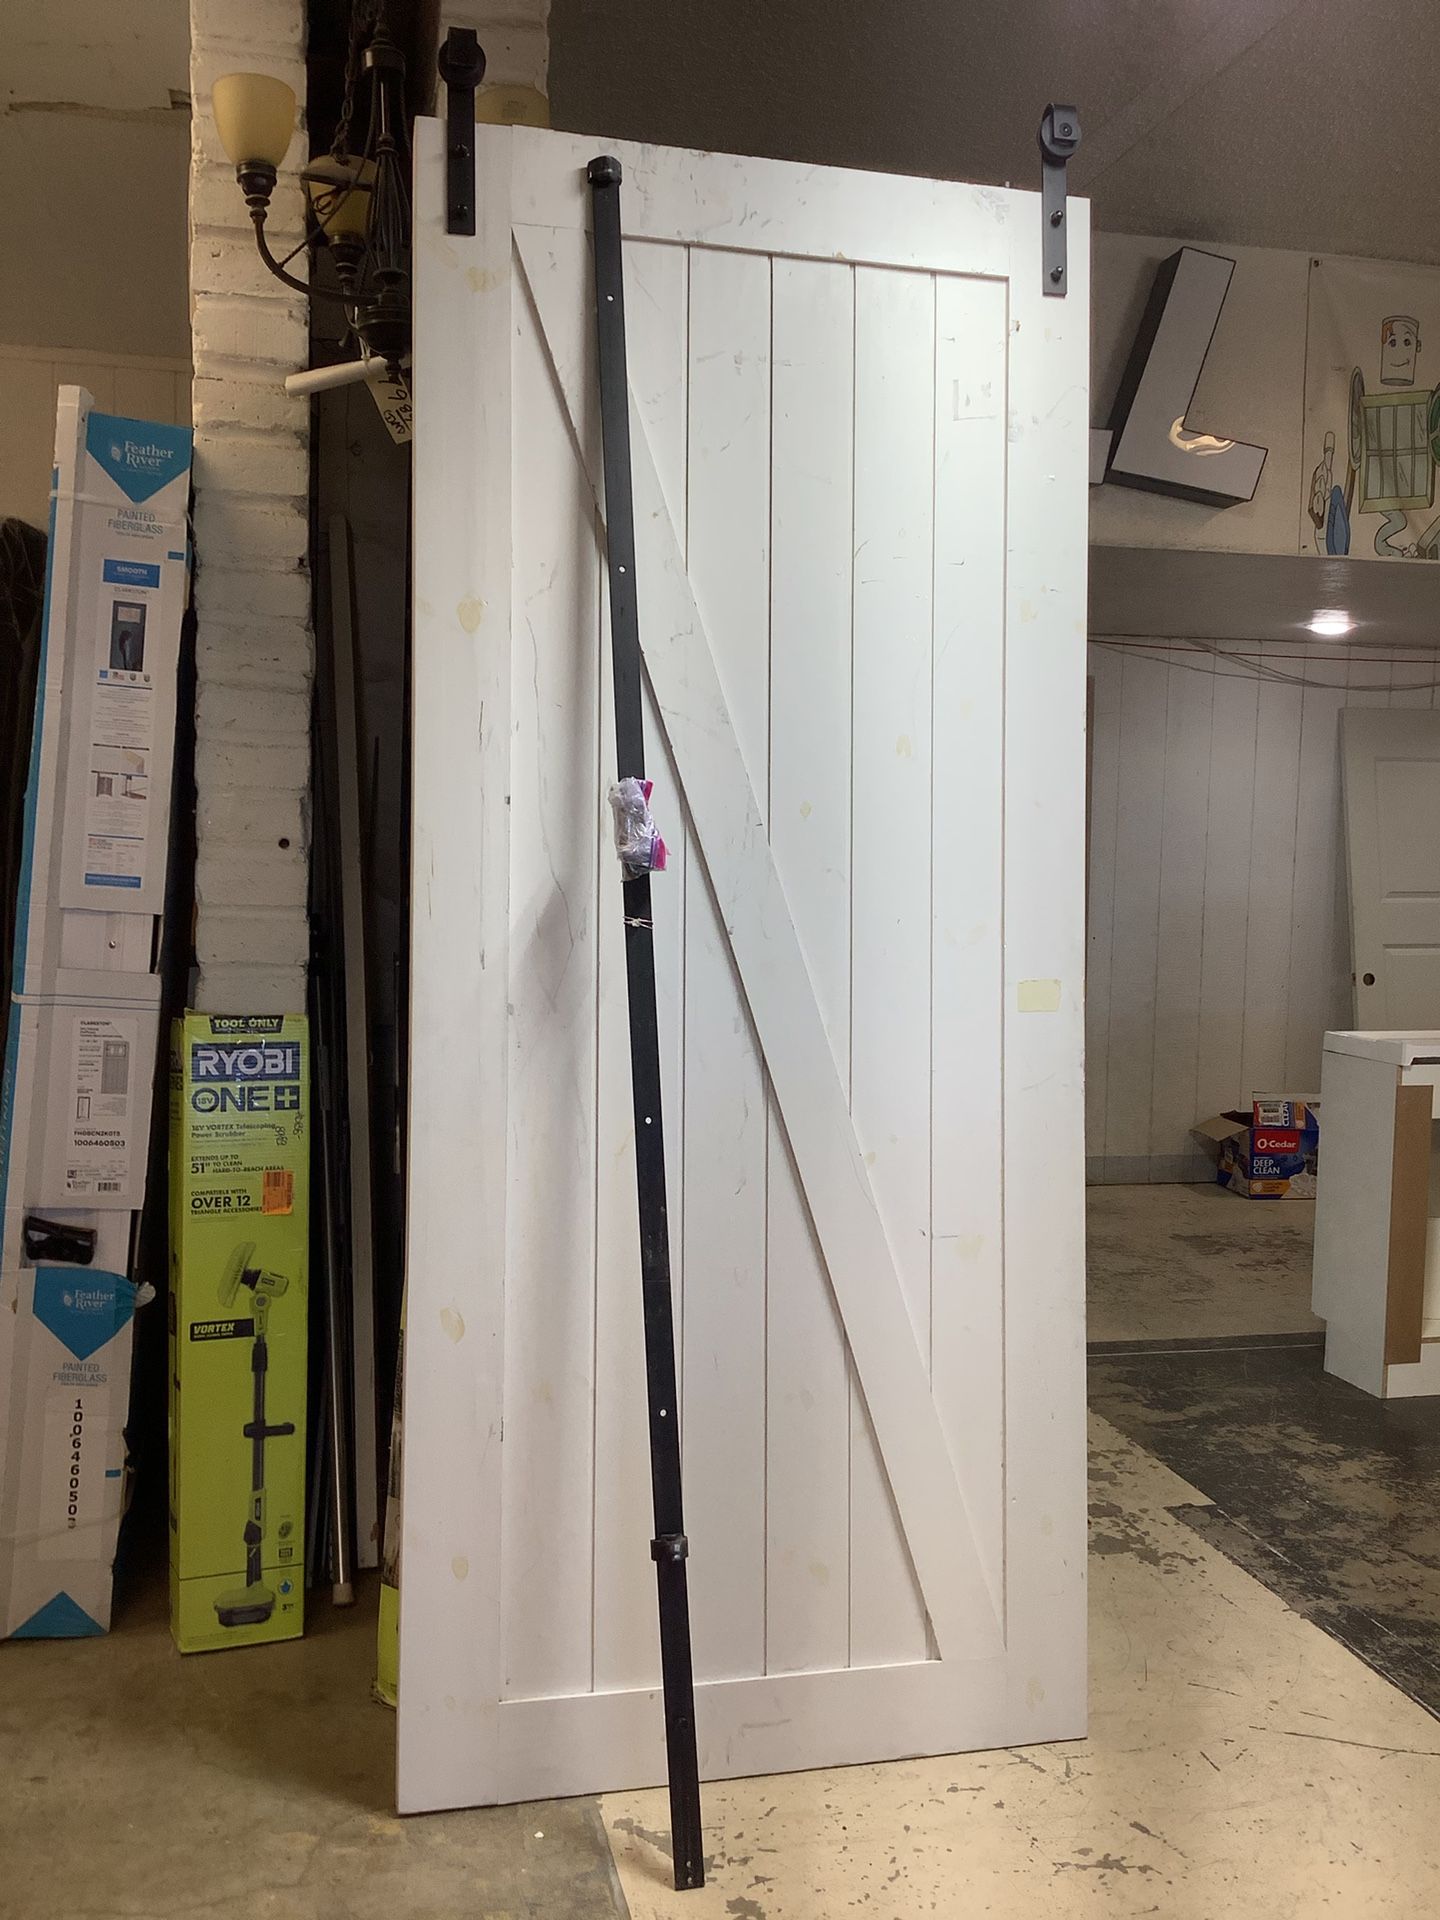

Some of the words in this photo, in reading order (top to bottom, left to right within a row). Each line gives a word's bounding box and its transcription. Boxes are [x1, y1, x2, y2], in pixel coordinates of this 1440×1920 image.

[124, 441, 174, 459] Feather
[126, 453, 161, 468] River
[117, 508, 156, 522] PAINTED
[107, 519, 163, 535] FIBERGLASS
[116, 566, 148, 576] SMOOTH
[214, 1019, 246, 1028] TOOL
[248, 1018, 279, 1028] ONLY
[197, 1048, 293, 1076] RYOBI
[1253, 1159, 1274, 1167] DEEP
[1253, 1167, 1281, 1175] CLEAN
[191, 1189, 229, 1197] COMPATIBLE
[191, 1196, 232, 1209] OVER
[236, 1195, 251, 1207] 12
[75, 1289, 115, 1301] Feather
[75, 1299, 106, 1310] River
[193, 1322, 236, 1334] VORTEX
[62, 1362, 99, 1373] PAINTED
[53, 1373, 107, 1383] FIBERGLASS
